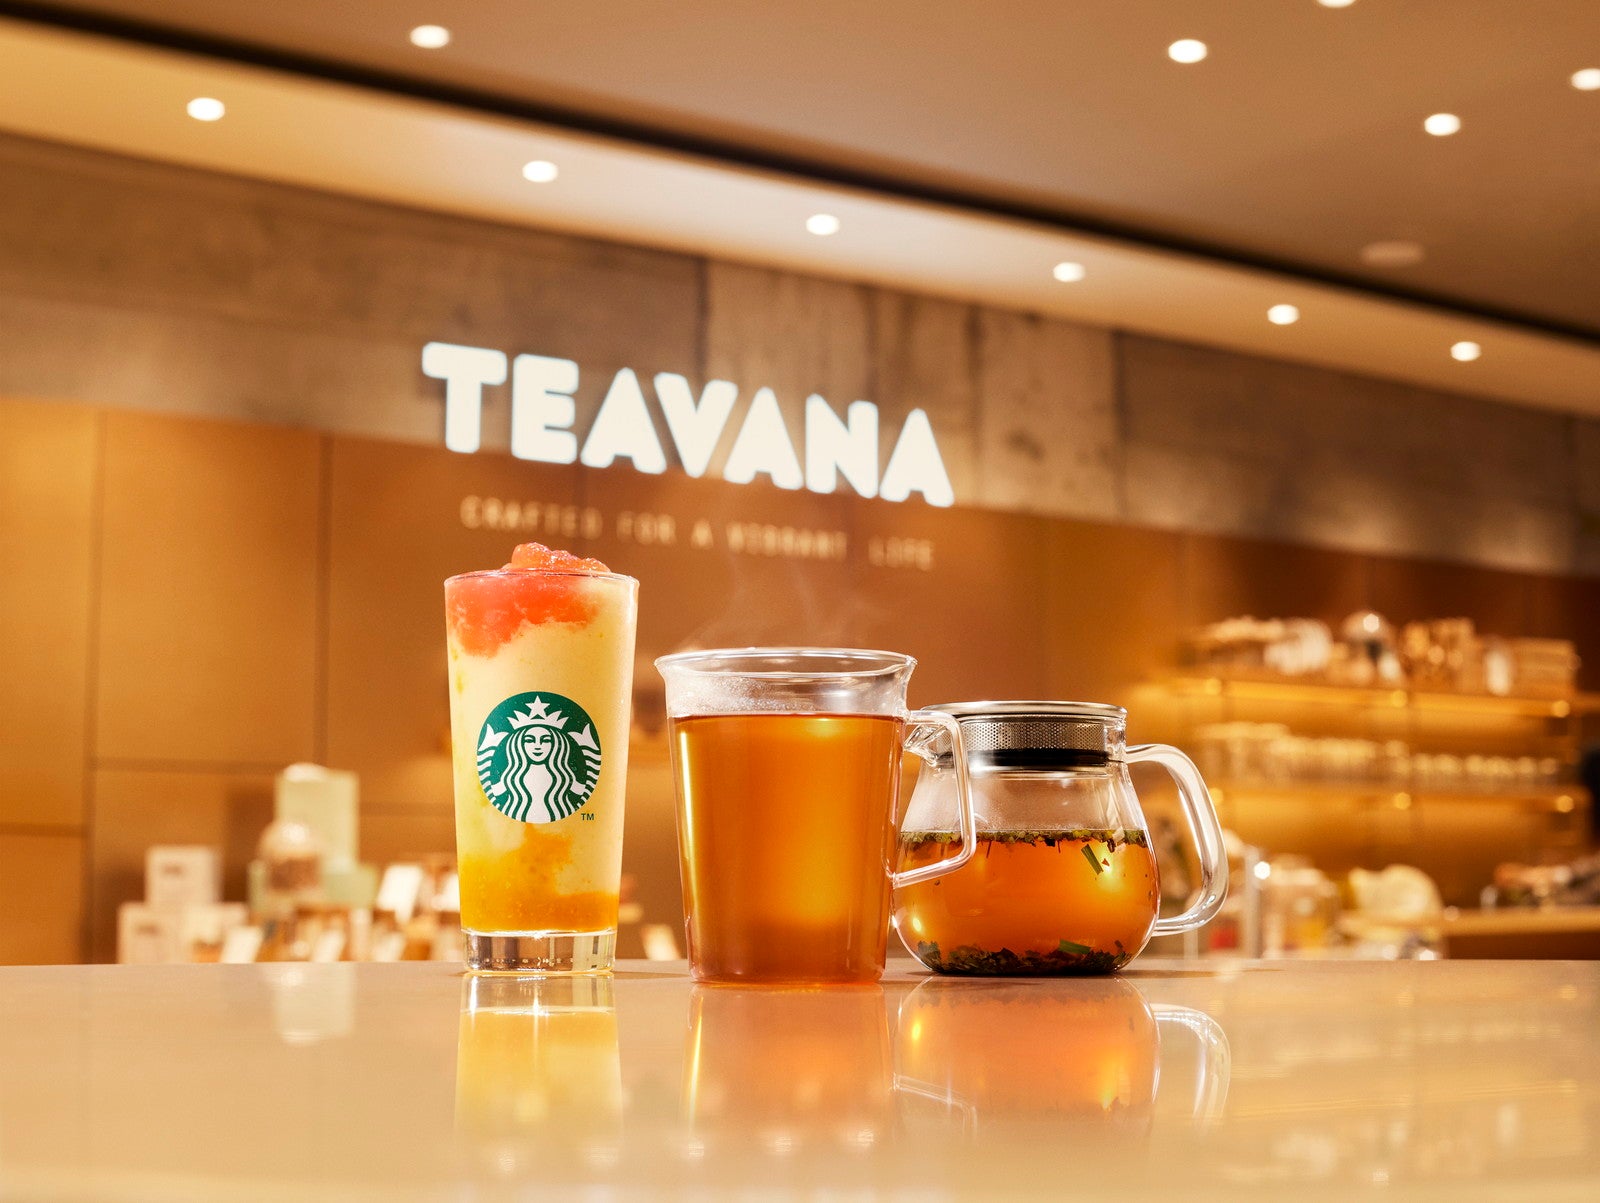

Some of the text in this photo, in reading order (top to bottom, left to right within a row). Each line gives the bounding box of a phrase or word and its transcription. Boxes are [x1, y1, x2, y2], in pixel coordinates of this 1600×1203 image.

[422, 342, 955, 507] TEAVANA
[461, 495, 602, 541] CRAFTED
[617, 510, 677, 546] FOR
[691, 519, 714, 549] A
[581, 813, 594, 821] TM
